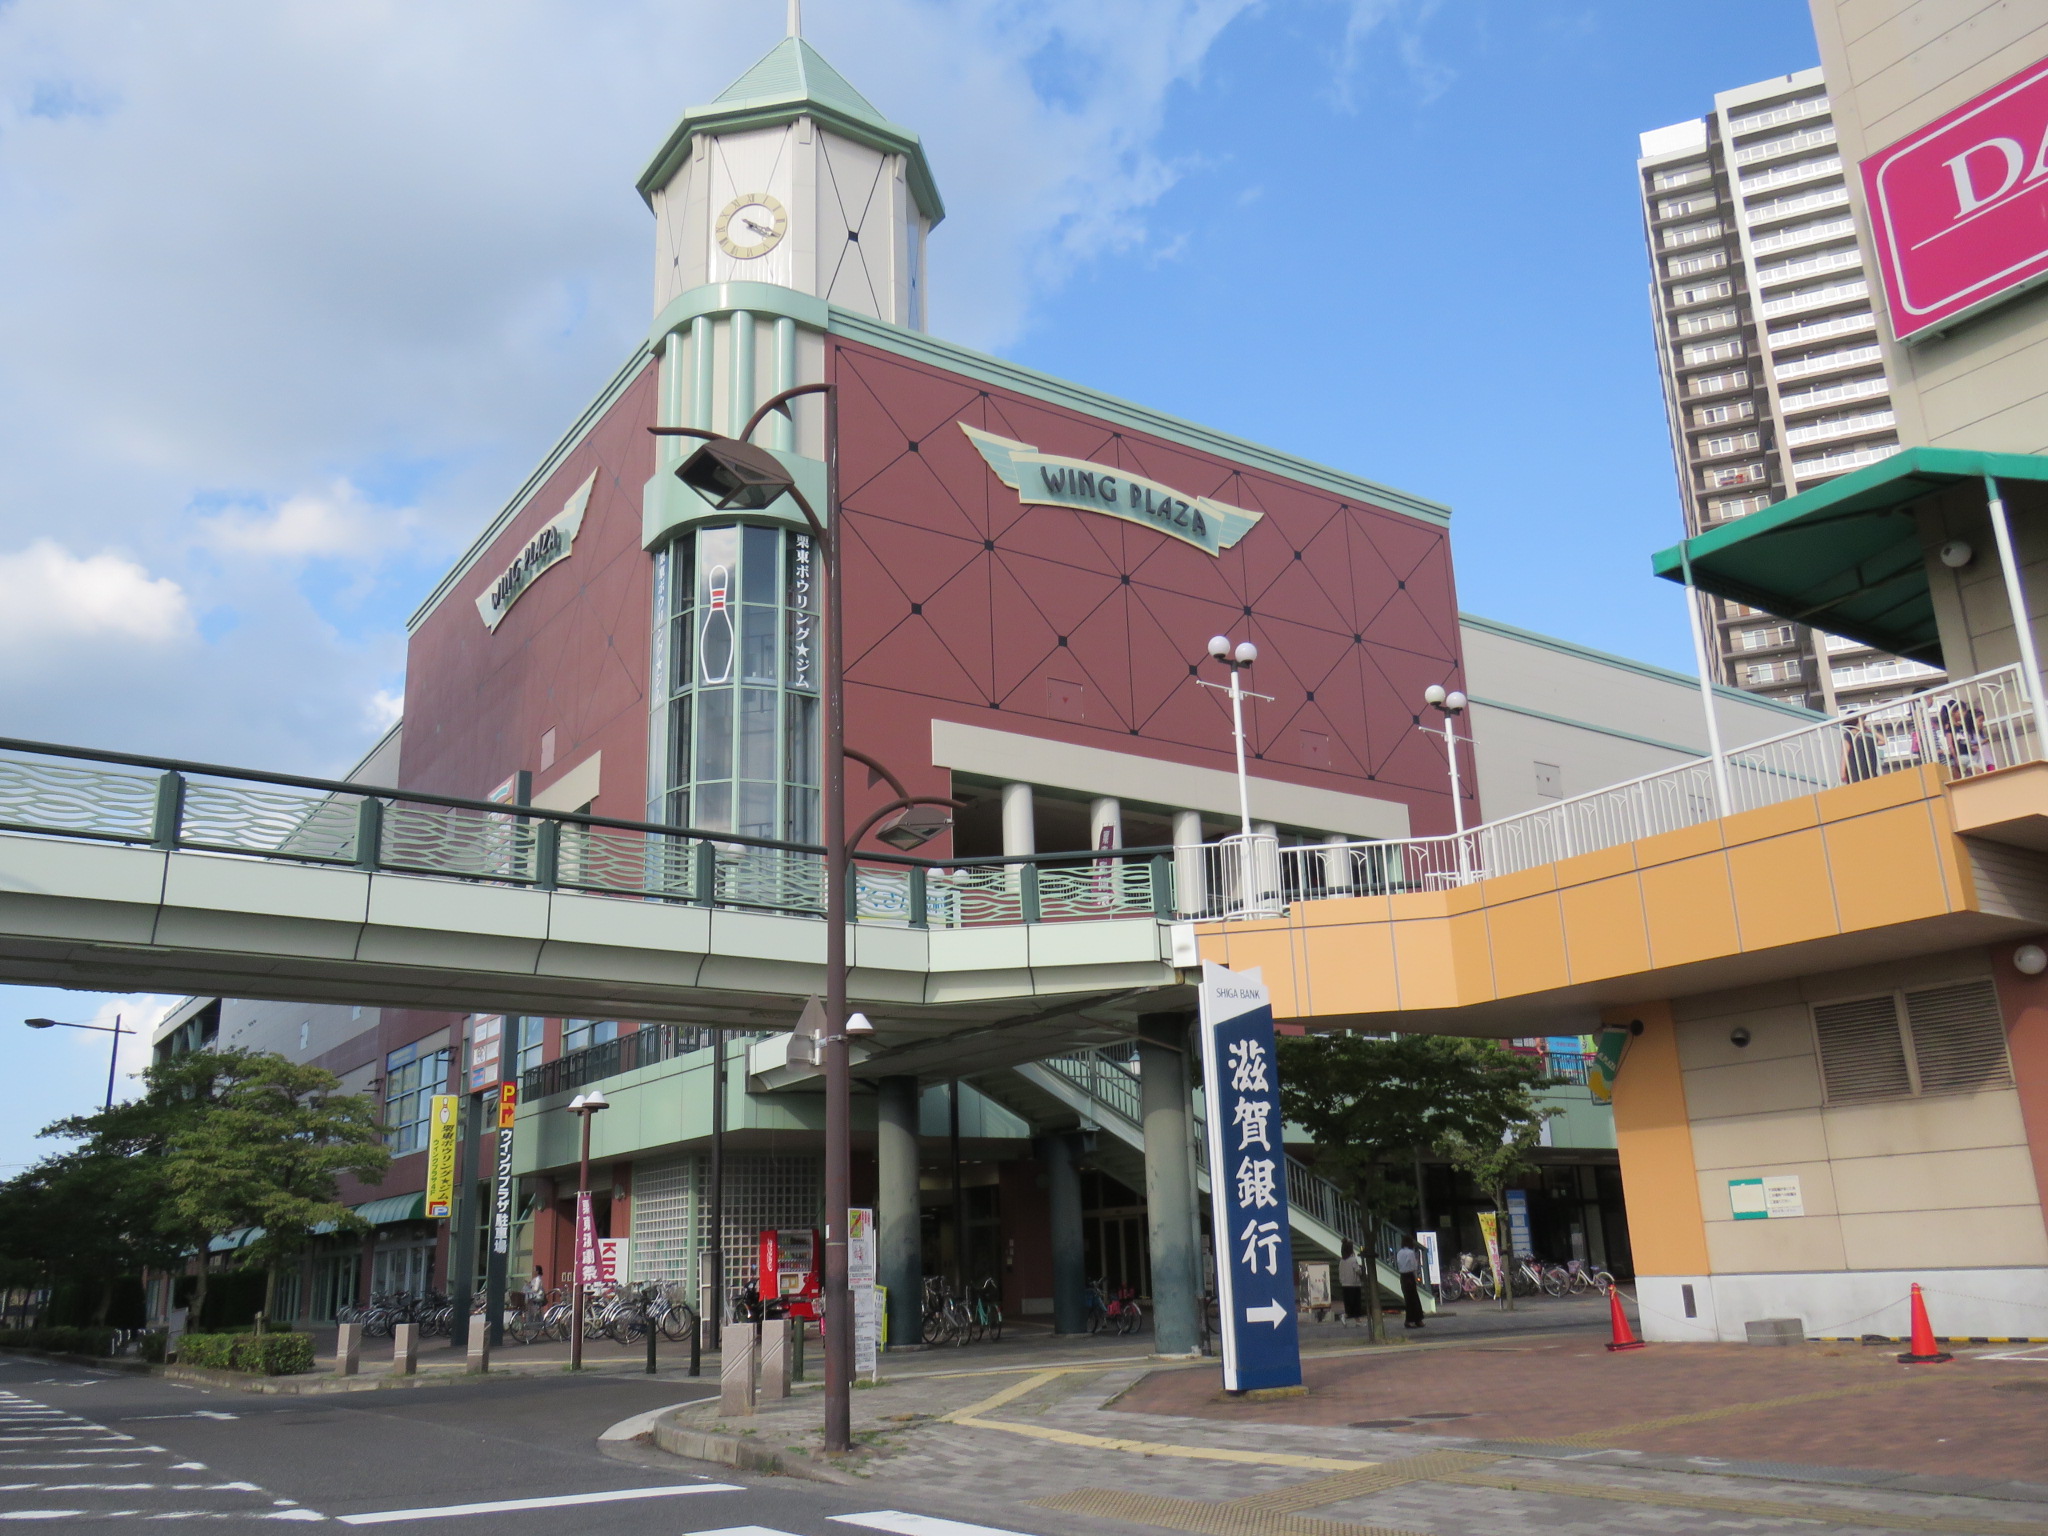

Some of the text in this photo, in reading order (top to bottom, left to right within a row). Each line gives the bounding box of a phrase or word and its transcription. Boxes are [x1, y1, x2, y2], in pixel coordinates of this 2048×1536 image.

[1040, 465, 1207, 536] WING PLAZA
[491, 525, 558, 610] WING PLAZA
[1215, 987, 1261, 1000] SHIGA BANK
[503, 1084, 516, 1103] P
[1228, 1039, 1282, 1276] 滋賀銀行
